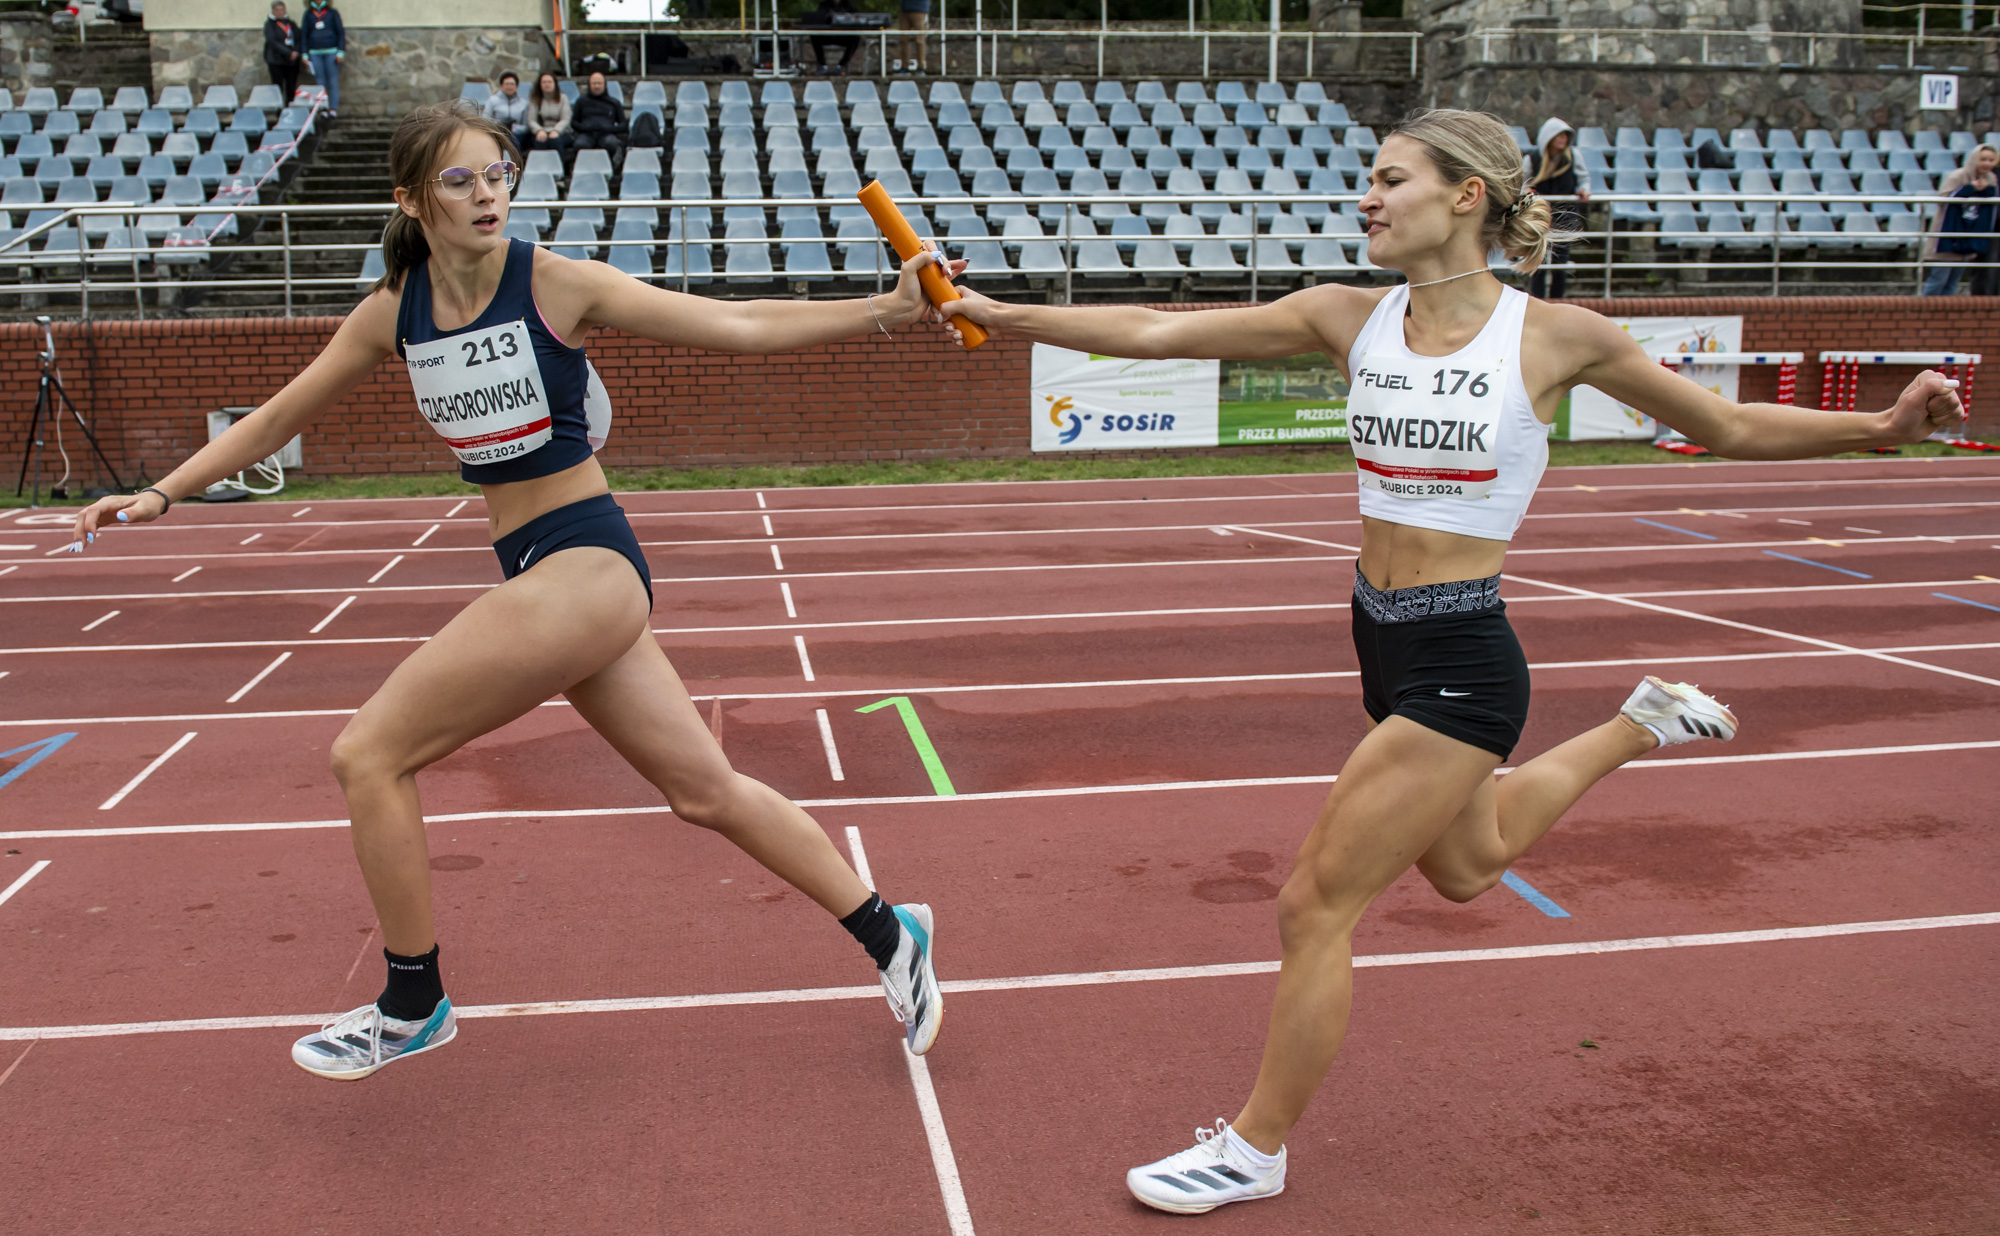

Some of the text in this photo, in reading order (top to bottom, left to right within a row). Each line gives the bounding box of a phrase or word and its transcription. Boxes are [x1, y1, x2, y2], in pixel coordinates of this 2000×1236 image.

[1928, 80, 1952, 104] VIP
[283, 110, 293, 124] 2
[461, 332, 519, 367] 213
[417, 355, 445, 369] SPORT
[1365, 372, 1413, 391] FUEL
[1432, 368, 1490, 398] 176
[420, 377, 540, 424] CZACHOROWSKA
[1101, 413, 1175, 432] SOSiR
[1296, 408, 1346, 421] PRZEDSI
[1238, 426, 1348, 441] PRZEZ BURMISTRZ
[1352, 414, 1490, 453] SZWEDZIK
[493, 442, 525, 458] 2024
[1379, 479, 1463, 496] SŁUBICE 2024
[1395, 586, 1431, 602] PRO
[1432, 579, 1484, 597] NIKE
